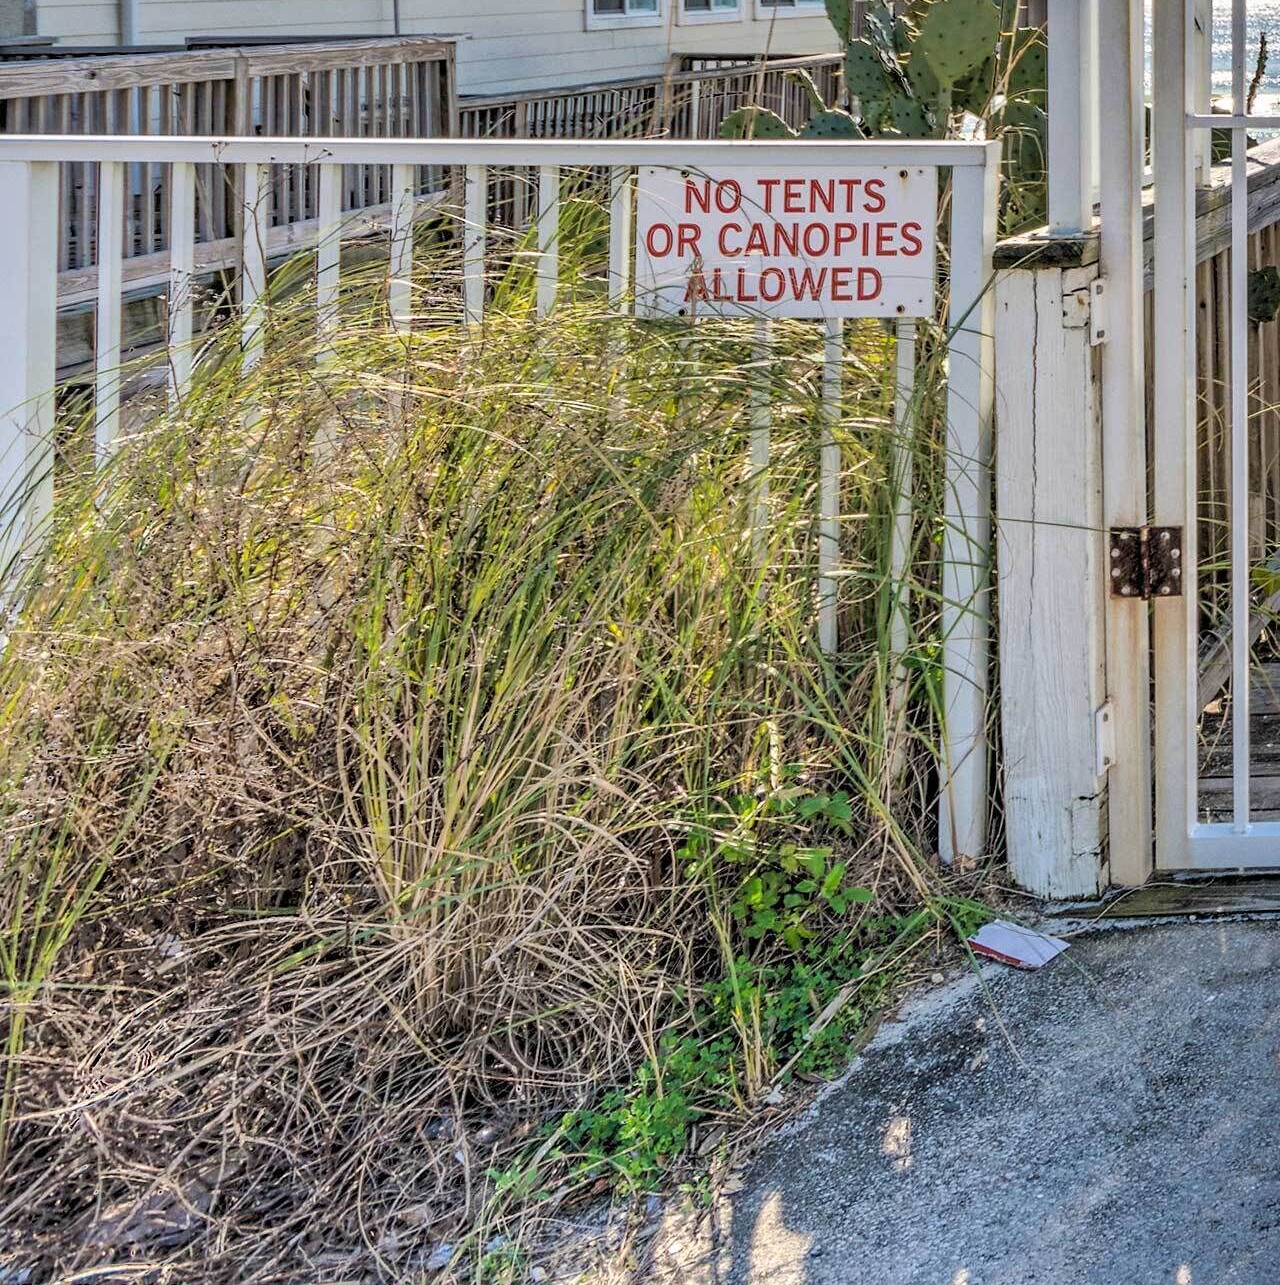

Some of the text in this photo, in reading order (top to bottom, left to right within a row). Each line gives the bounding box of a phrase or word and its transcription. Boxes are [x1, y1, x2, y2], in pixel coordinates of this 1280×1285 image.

[684, 179, 886, 214] NO TENTS
[646, 222, 923, 257] OR CANOPIES
[683, 267, 883, 303] ALLOWED
